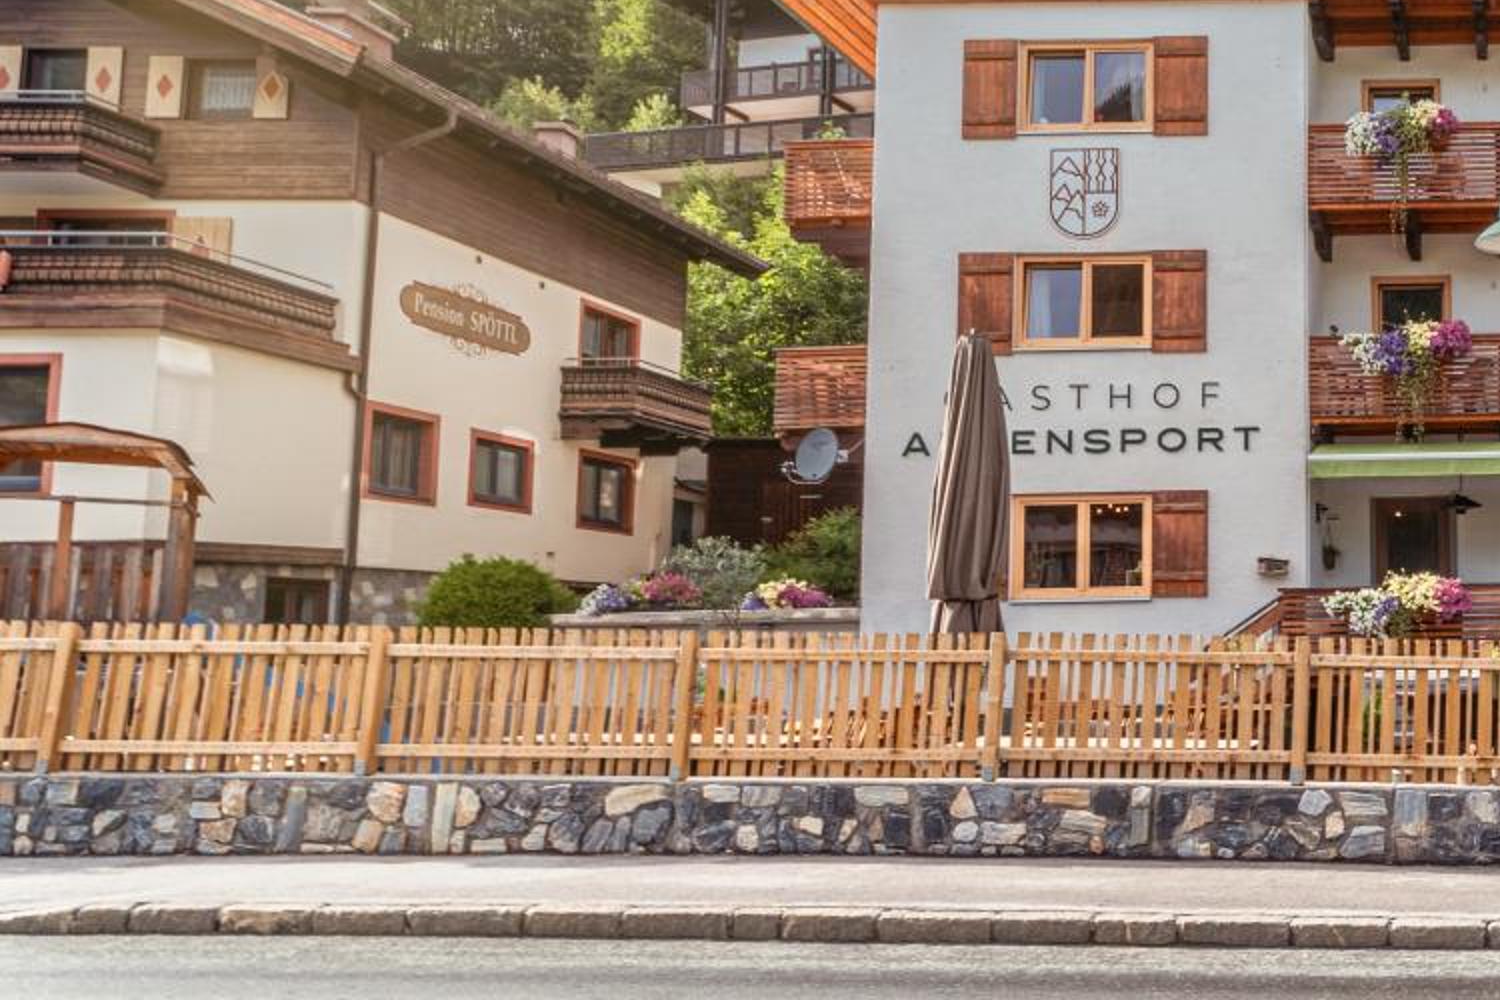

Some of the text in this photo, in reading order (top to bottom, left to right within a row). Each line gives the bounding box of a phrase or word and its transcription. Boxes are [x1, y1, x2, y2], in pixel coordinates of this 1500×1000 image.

[414, 292, 465, 327] Pension
[943, 381, 1220, 412] ASTHOF
[901, 426, 1261, 457] AENSPORT
